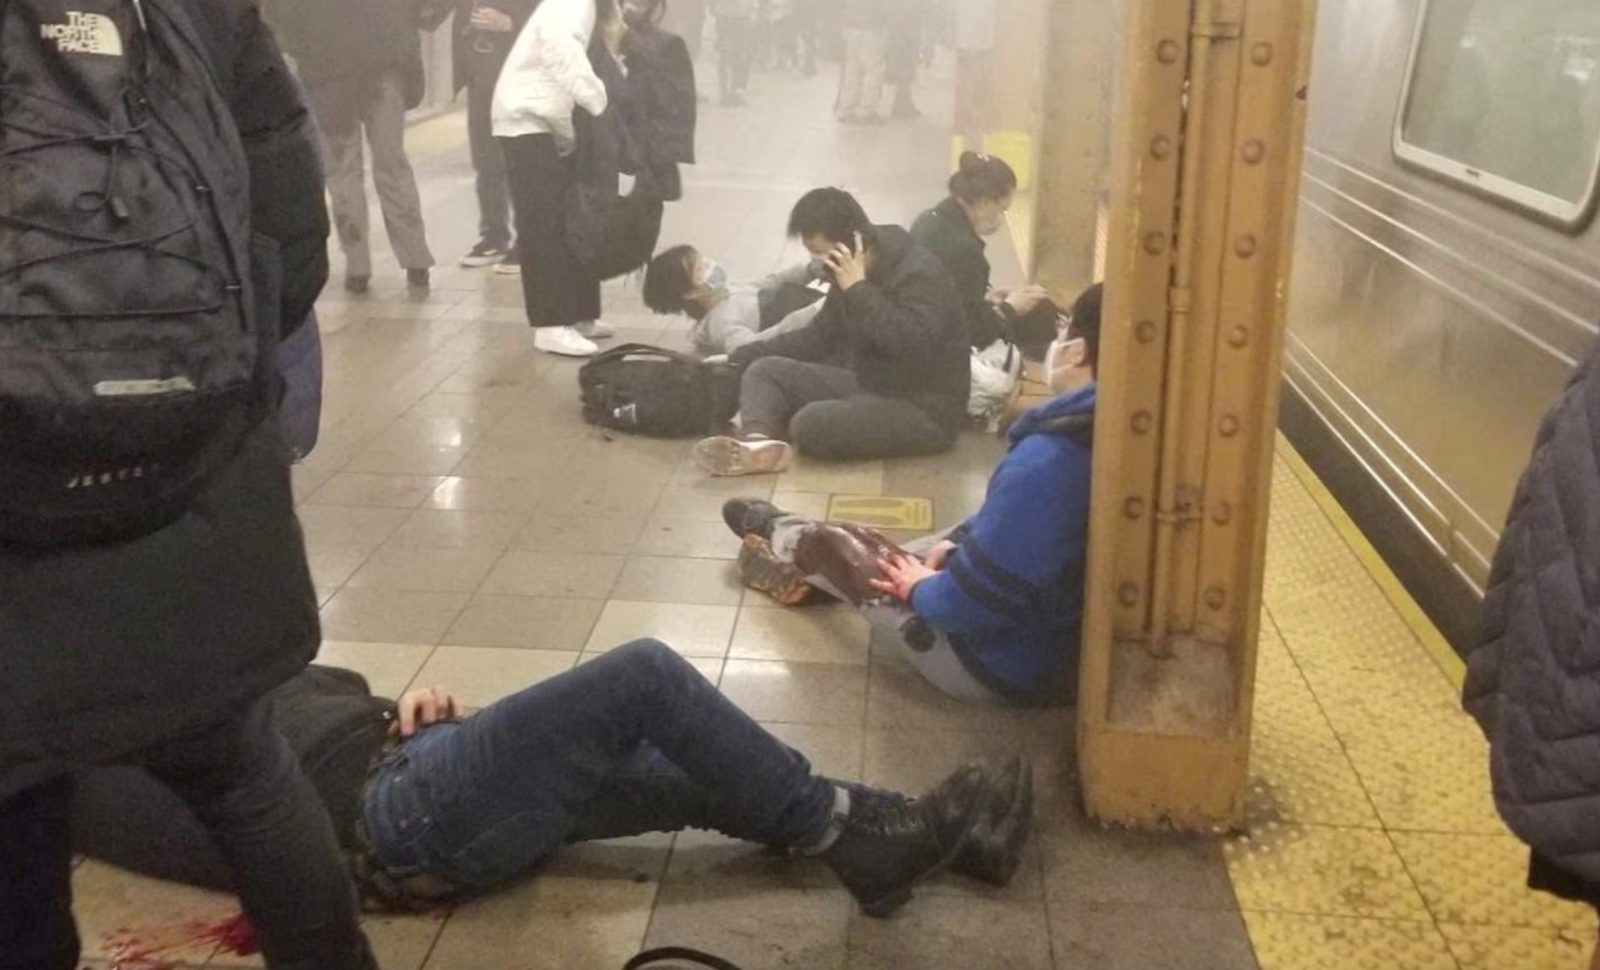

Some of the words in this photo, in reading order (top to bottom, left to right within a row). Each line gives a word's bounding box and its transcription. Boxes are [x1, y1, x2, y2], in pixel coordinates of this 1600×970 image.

[66, 11, 97, 26] THE
[40, 24, 96, 40] NORTH
[58, 39, 98, 53] FACE
